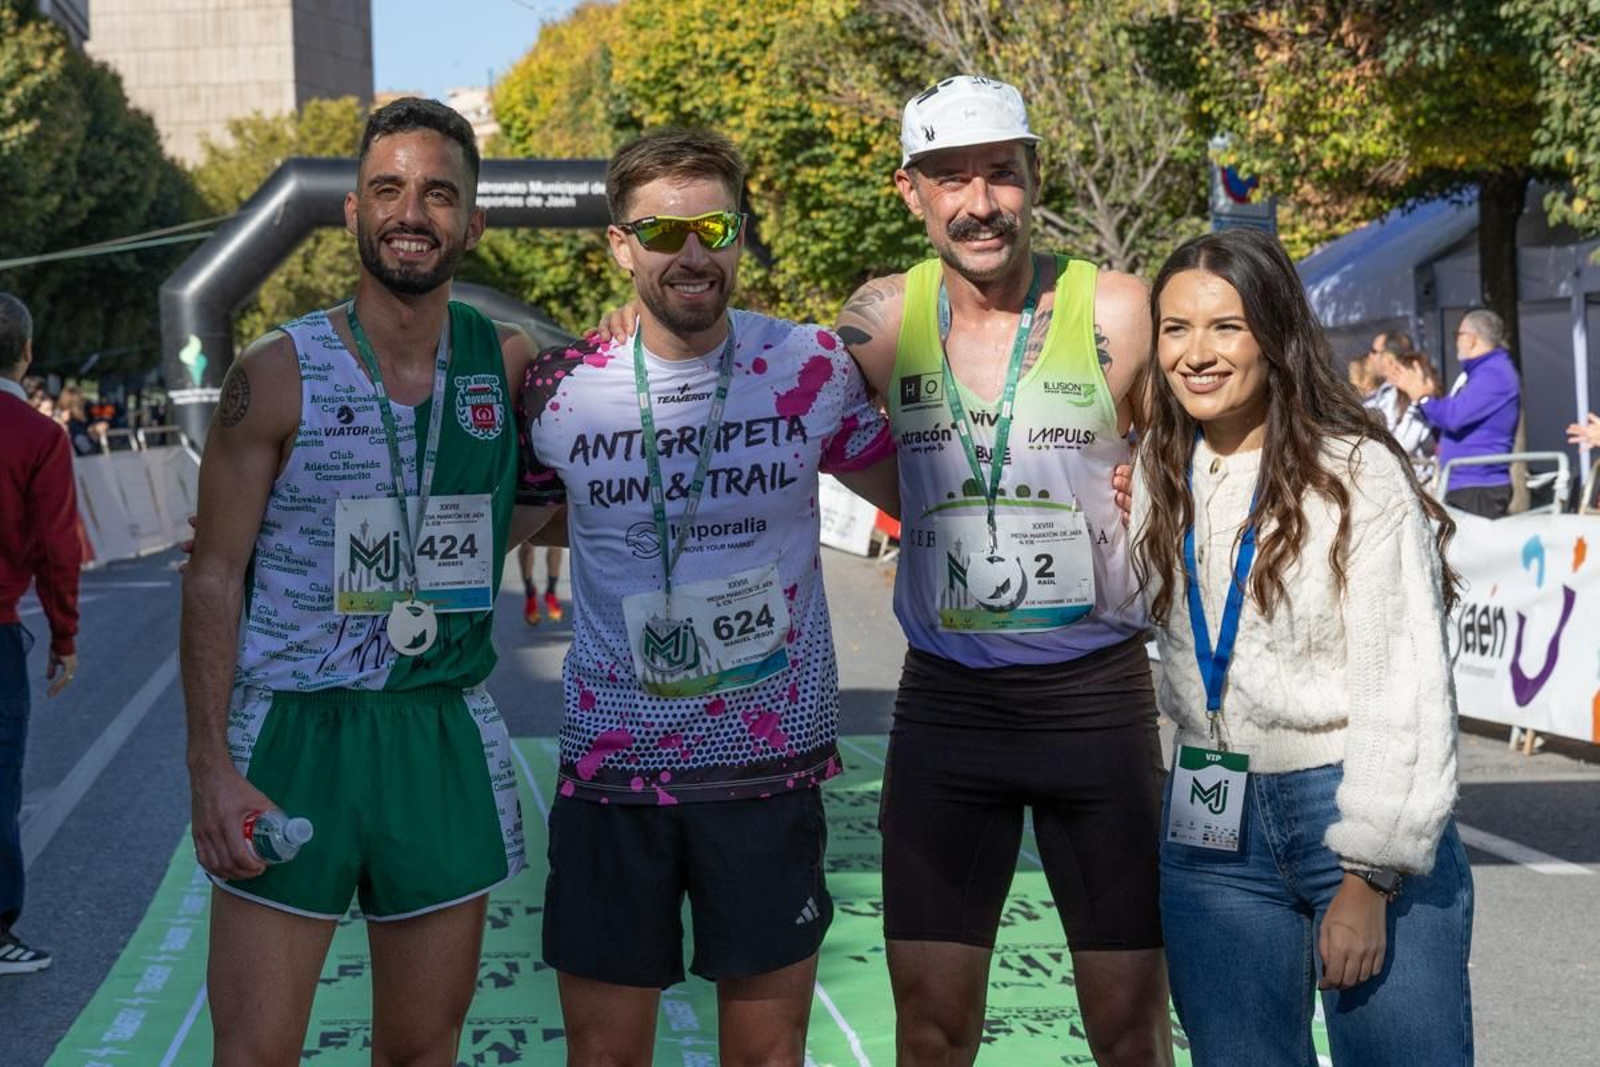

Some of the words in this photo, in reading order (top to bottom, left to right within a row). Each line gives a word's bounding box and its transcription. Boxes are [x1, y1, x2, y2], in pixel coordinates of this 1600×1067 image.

[906, 383, 916, 398] H
[657, 392, 713, 404] TEAMERGY
[969, 409, 1014, 428] viv
[324, 426, 369, 436] VIATOR
[569, 415, 808, 466] ANTIGRUPETA
[330, 451, 354, 460] Club
[976, 445, 1012, 461] BUE
[304, 462, 340, 471] Atlético
[342, 460, 380, 470] Novelda
[315, 472, 371, 481] Carmencita
[587, 476, 650, 508] RUN
[665, 472, 692, 501] &
[706, 462, 798, 499] TRAIL
[275, 543, 293, 554] Club
[416, 533, 478, 560] 424
[706, 543, 726, 551] YOUR
[727, 540, 755, 549] MARKET
[284, 555, 317, 567] Novelda
[1034, 553, 1055, 579] 2
[260, 560, 308, 576] Carmencita
[1037, 578, 1057, 586] RAÚL
[283, 588, 315, 602] Atlético
[257, 605, 278, 617] Club
[266, 618, 299, 632] Novelda
[712, 603, 775, 641] 624
[724, 636, 752, 647] MANUEL
[1206, 753, 1222, 761] VIP
